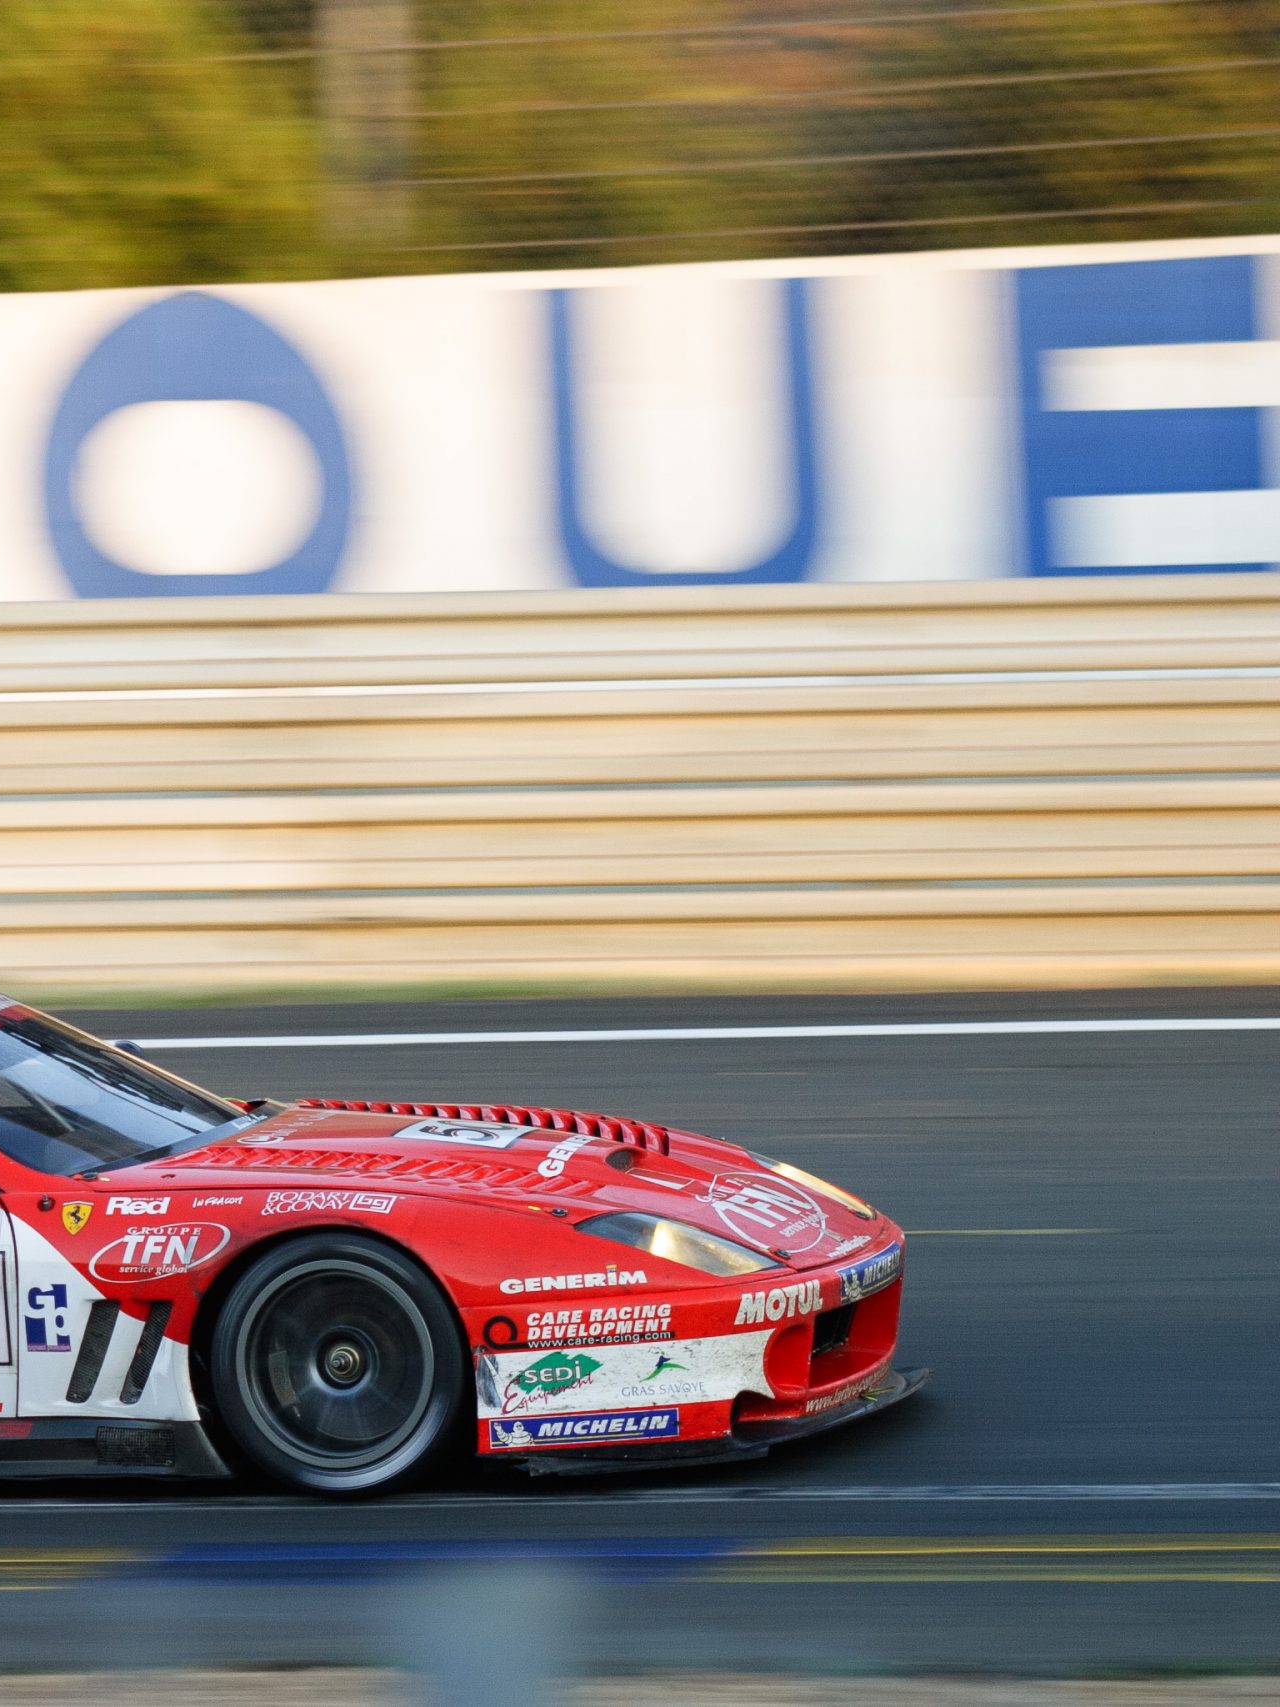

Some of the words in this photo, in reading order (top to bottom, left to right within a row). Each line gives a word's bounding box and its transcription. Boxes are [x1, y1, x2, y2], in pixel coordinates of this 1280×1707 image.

[106, 1196, 171, 1216] Red
[267, 1191, 354, 1203] BODART
[127, 1226, 202, 1236] GROUPE
[122, 1235, 199, 1265] TFN
[119, 1264, 155, 1273] service
[155, 1263, 188, 1276] global
[863, 1248, 900, 1287] MICHELIN
[499, 1269, 648, 1295] GENERIM
[734, 1278, 824, 1325] MOTUL
[527, 1309, 584, 1327] CARE
[589, 1304, 672, 1322] RACING
[527, 1317, 672, 1340] DEVELOPMENT
[527, 1330, 672, 1349] www.care-racing.com
[621, 1386, 656, 1398] GRAS
[659, 1381, 705, 1394] SAVOYE
[538, 1414, 670, 1438] MICHELIN
